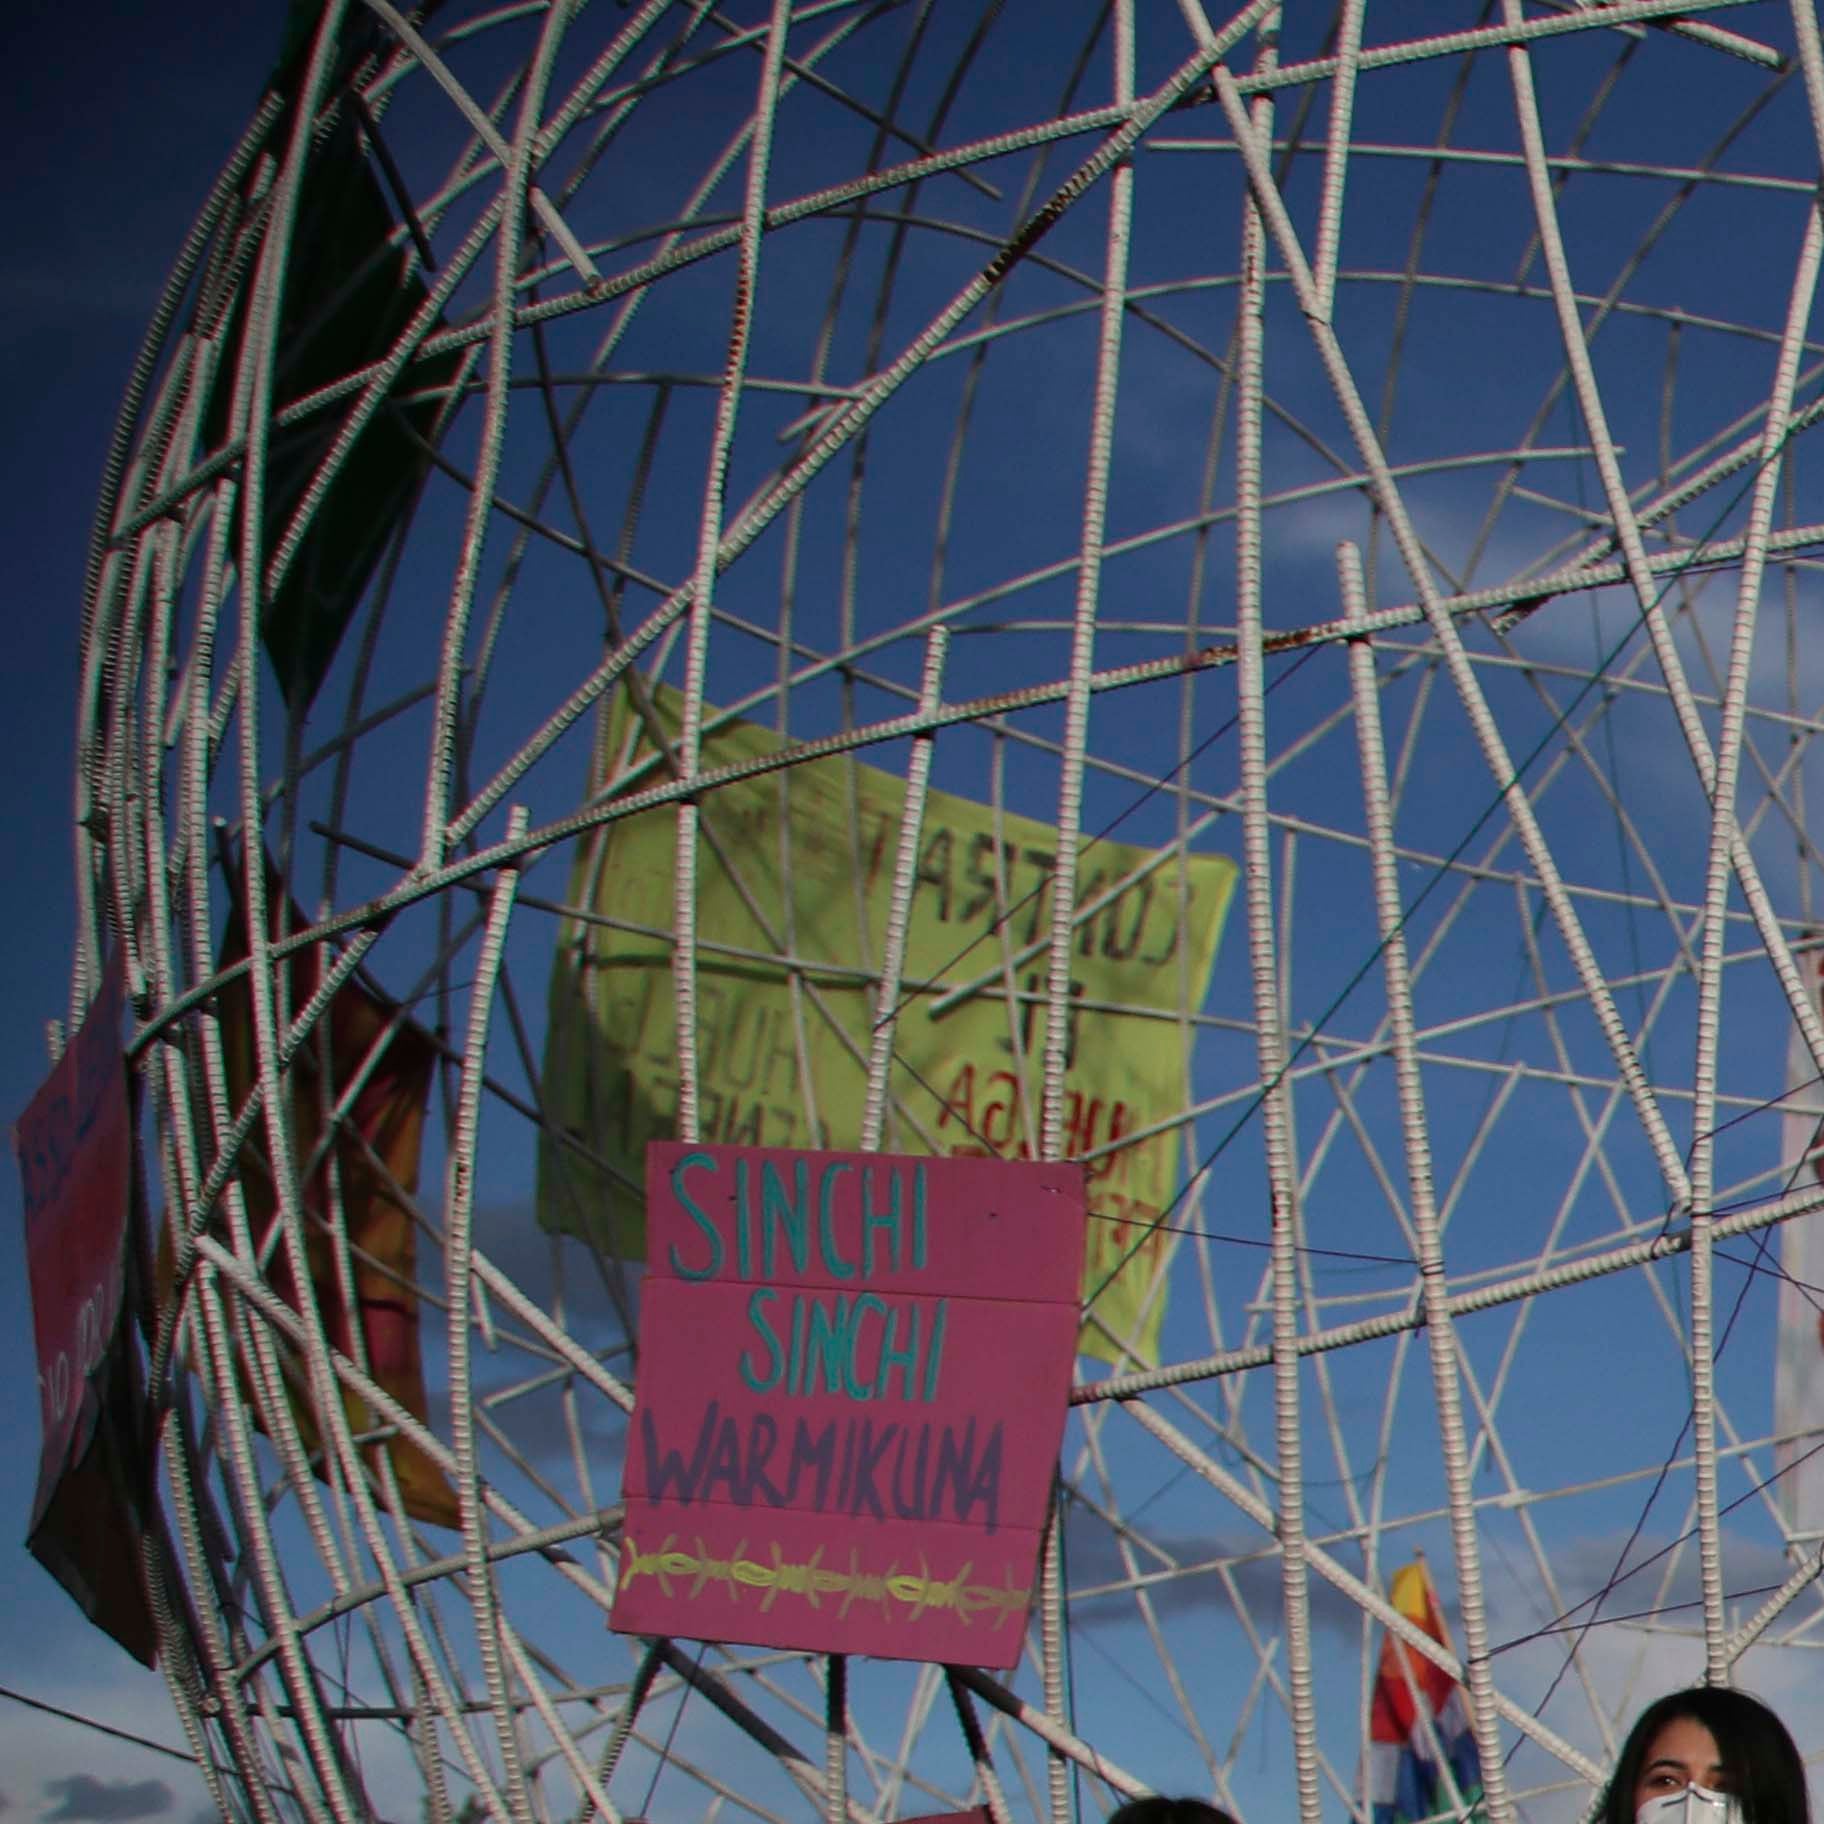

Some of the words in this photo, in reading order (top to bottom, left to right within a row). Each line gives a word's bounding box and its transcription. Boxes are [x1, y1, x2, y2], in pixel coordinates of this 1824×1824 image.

[668, 1151, 927, 1282] SINCHI
[740, 1286, 948, 1402] SINCHI
[641, 1401, 1003, 1535] WARMIKUNA
